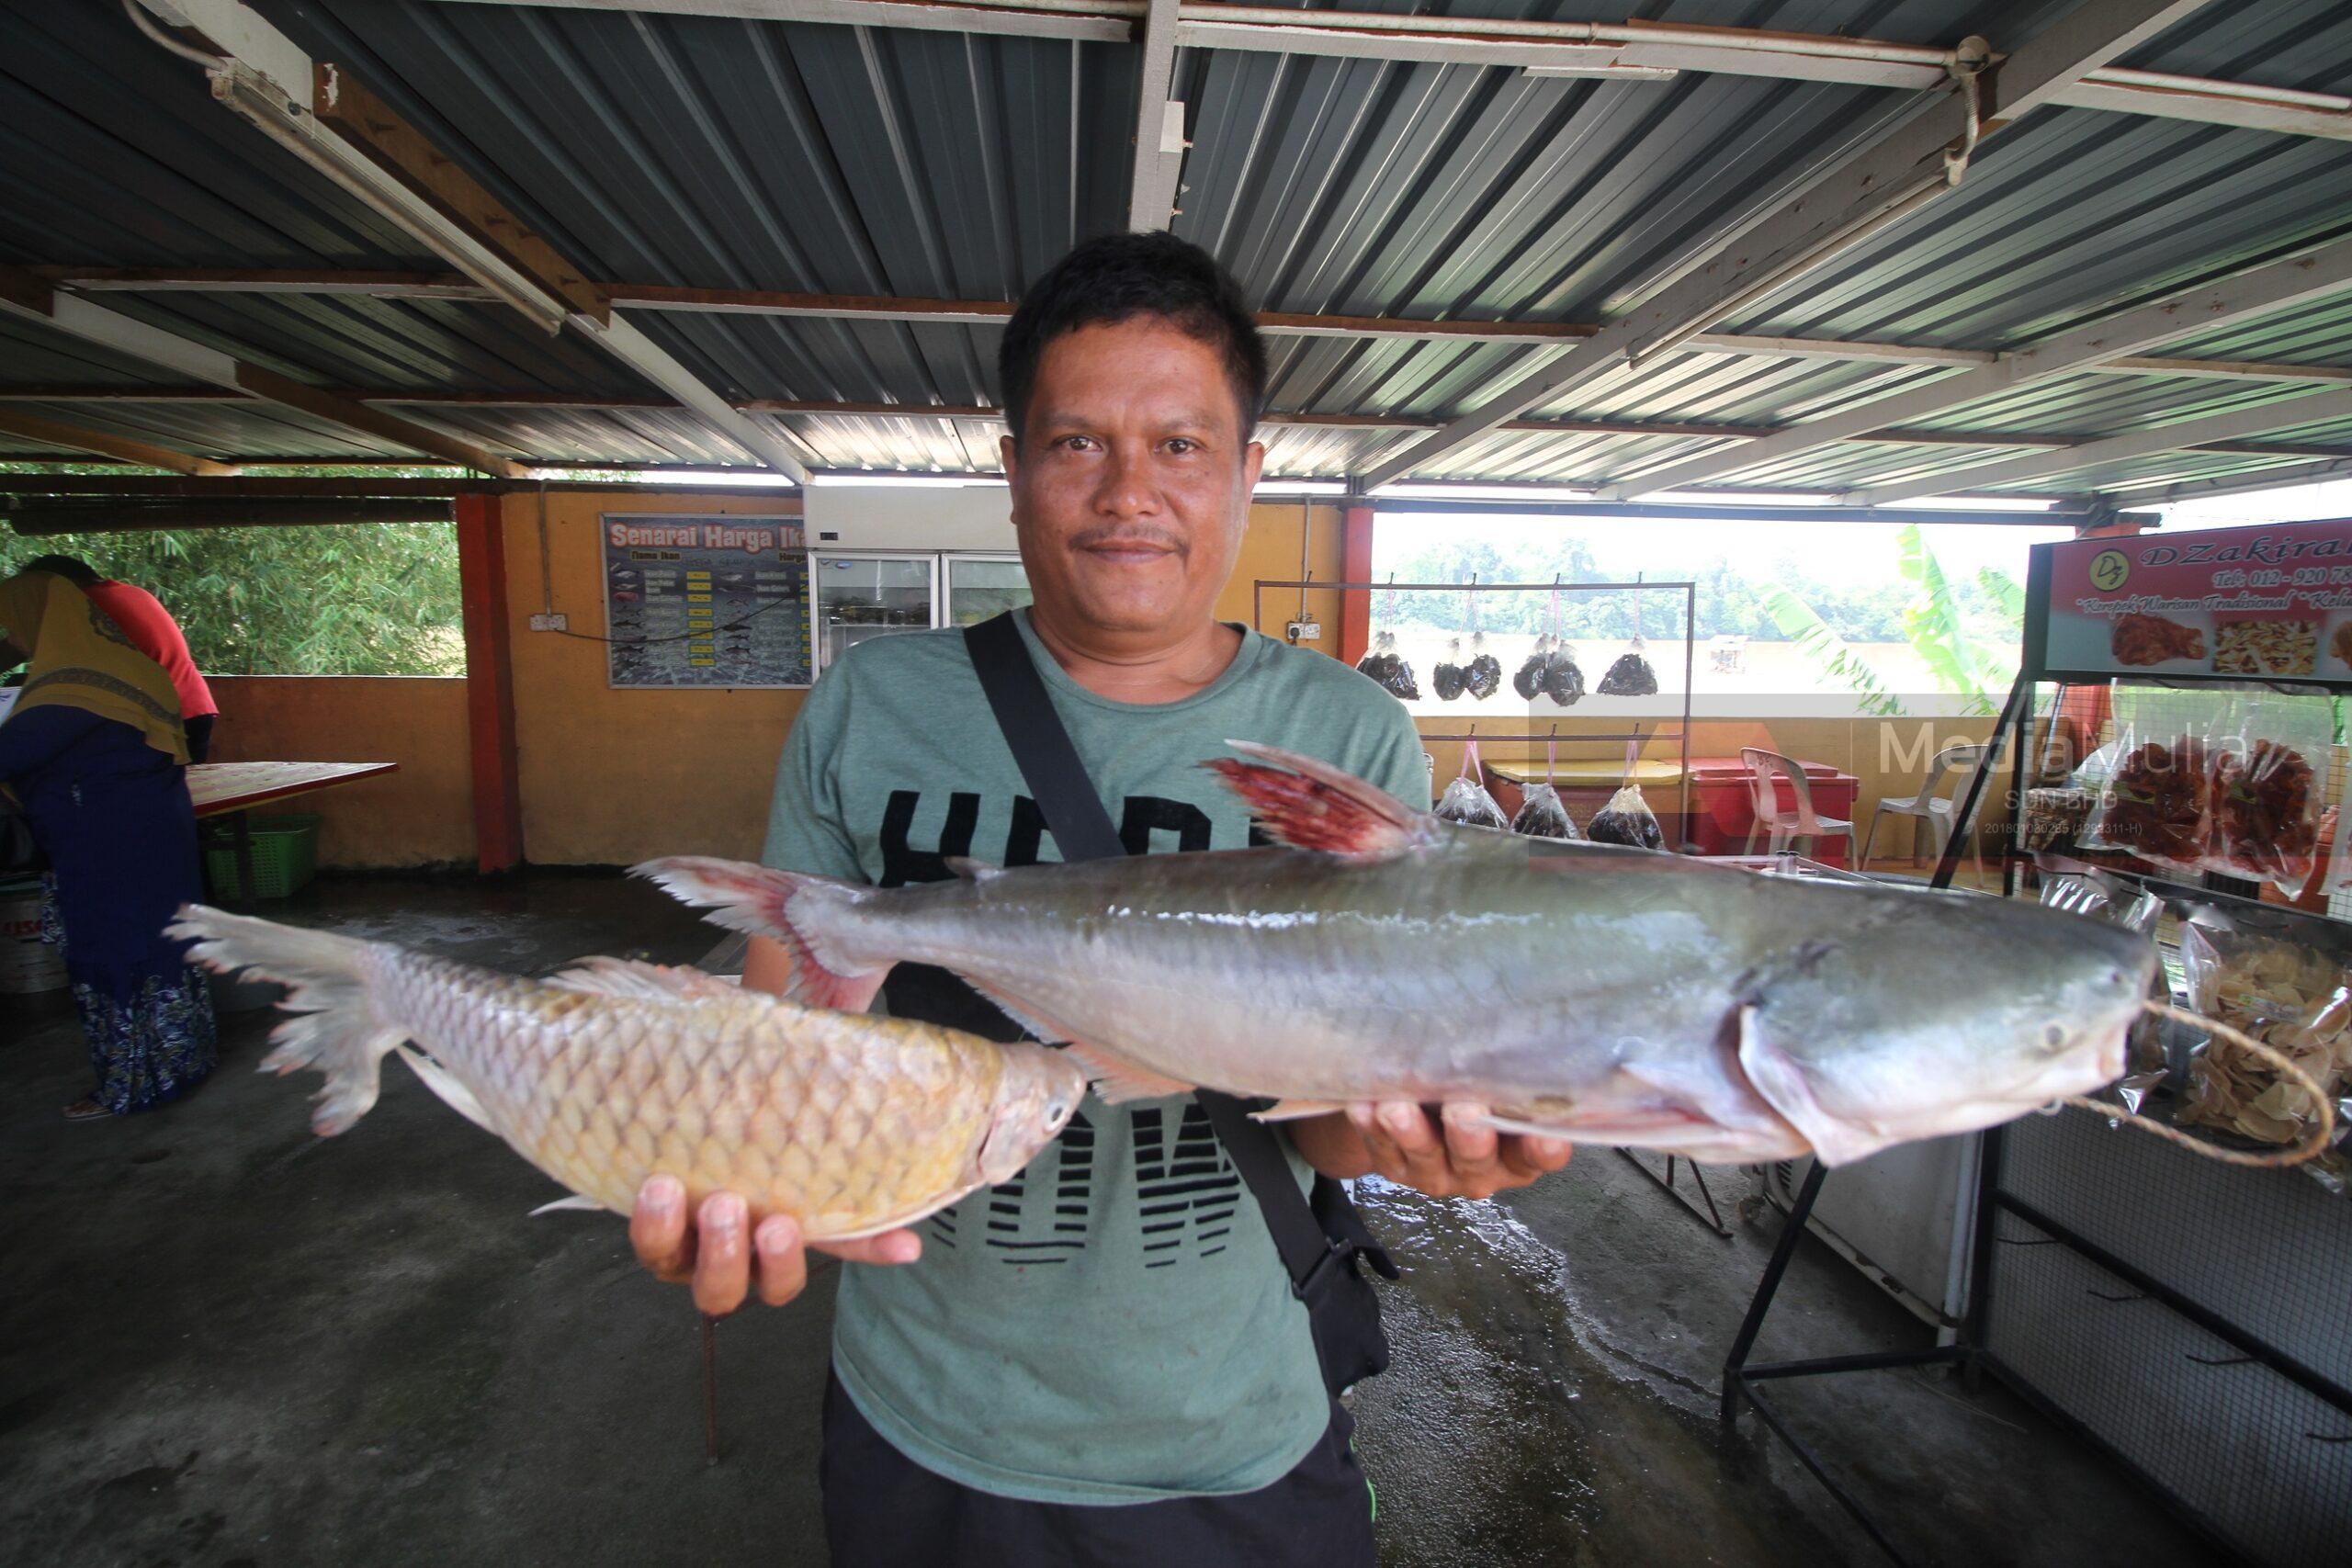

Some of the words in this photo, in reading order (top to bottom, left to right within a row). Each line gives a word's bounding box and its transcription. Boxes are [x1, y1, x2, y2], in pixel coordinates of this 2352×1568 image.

[608, 521, 698, 548] Senarai
[704, 524, 775, 555] Harga
[2141, 536, 2352, 567] DZakira
[2140, 594, 2200, 616] Warisan
